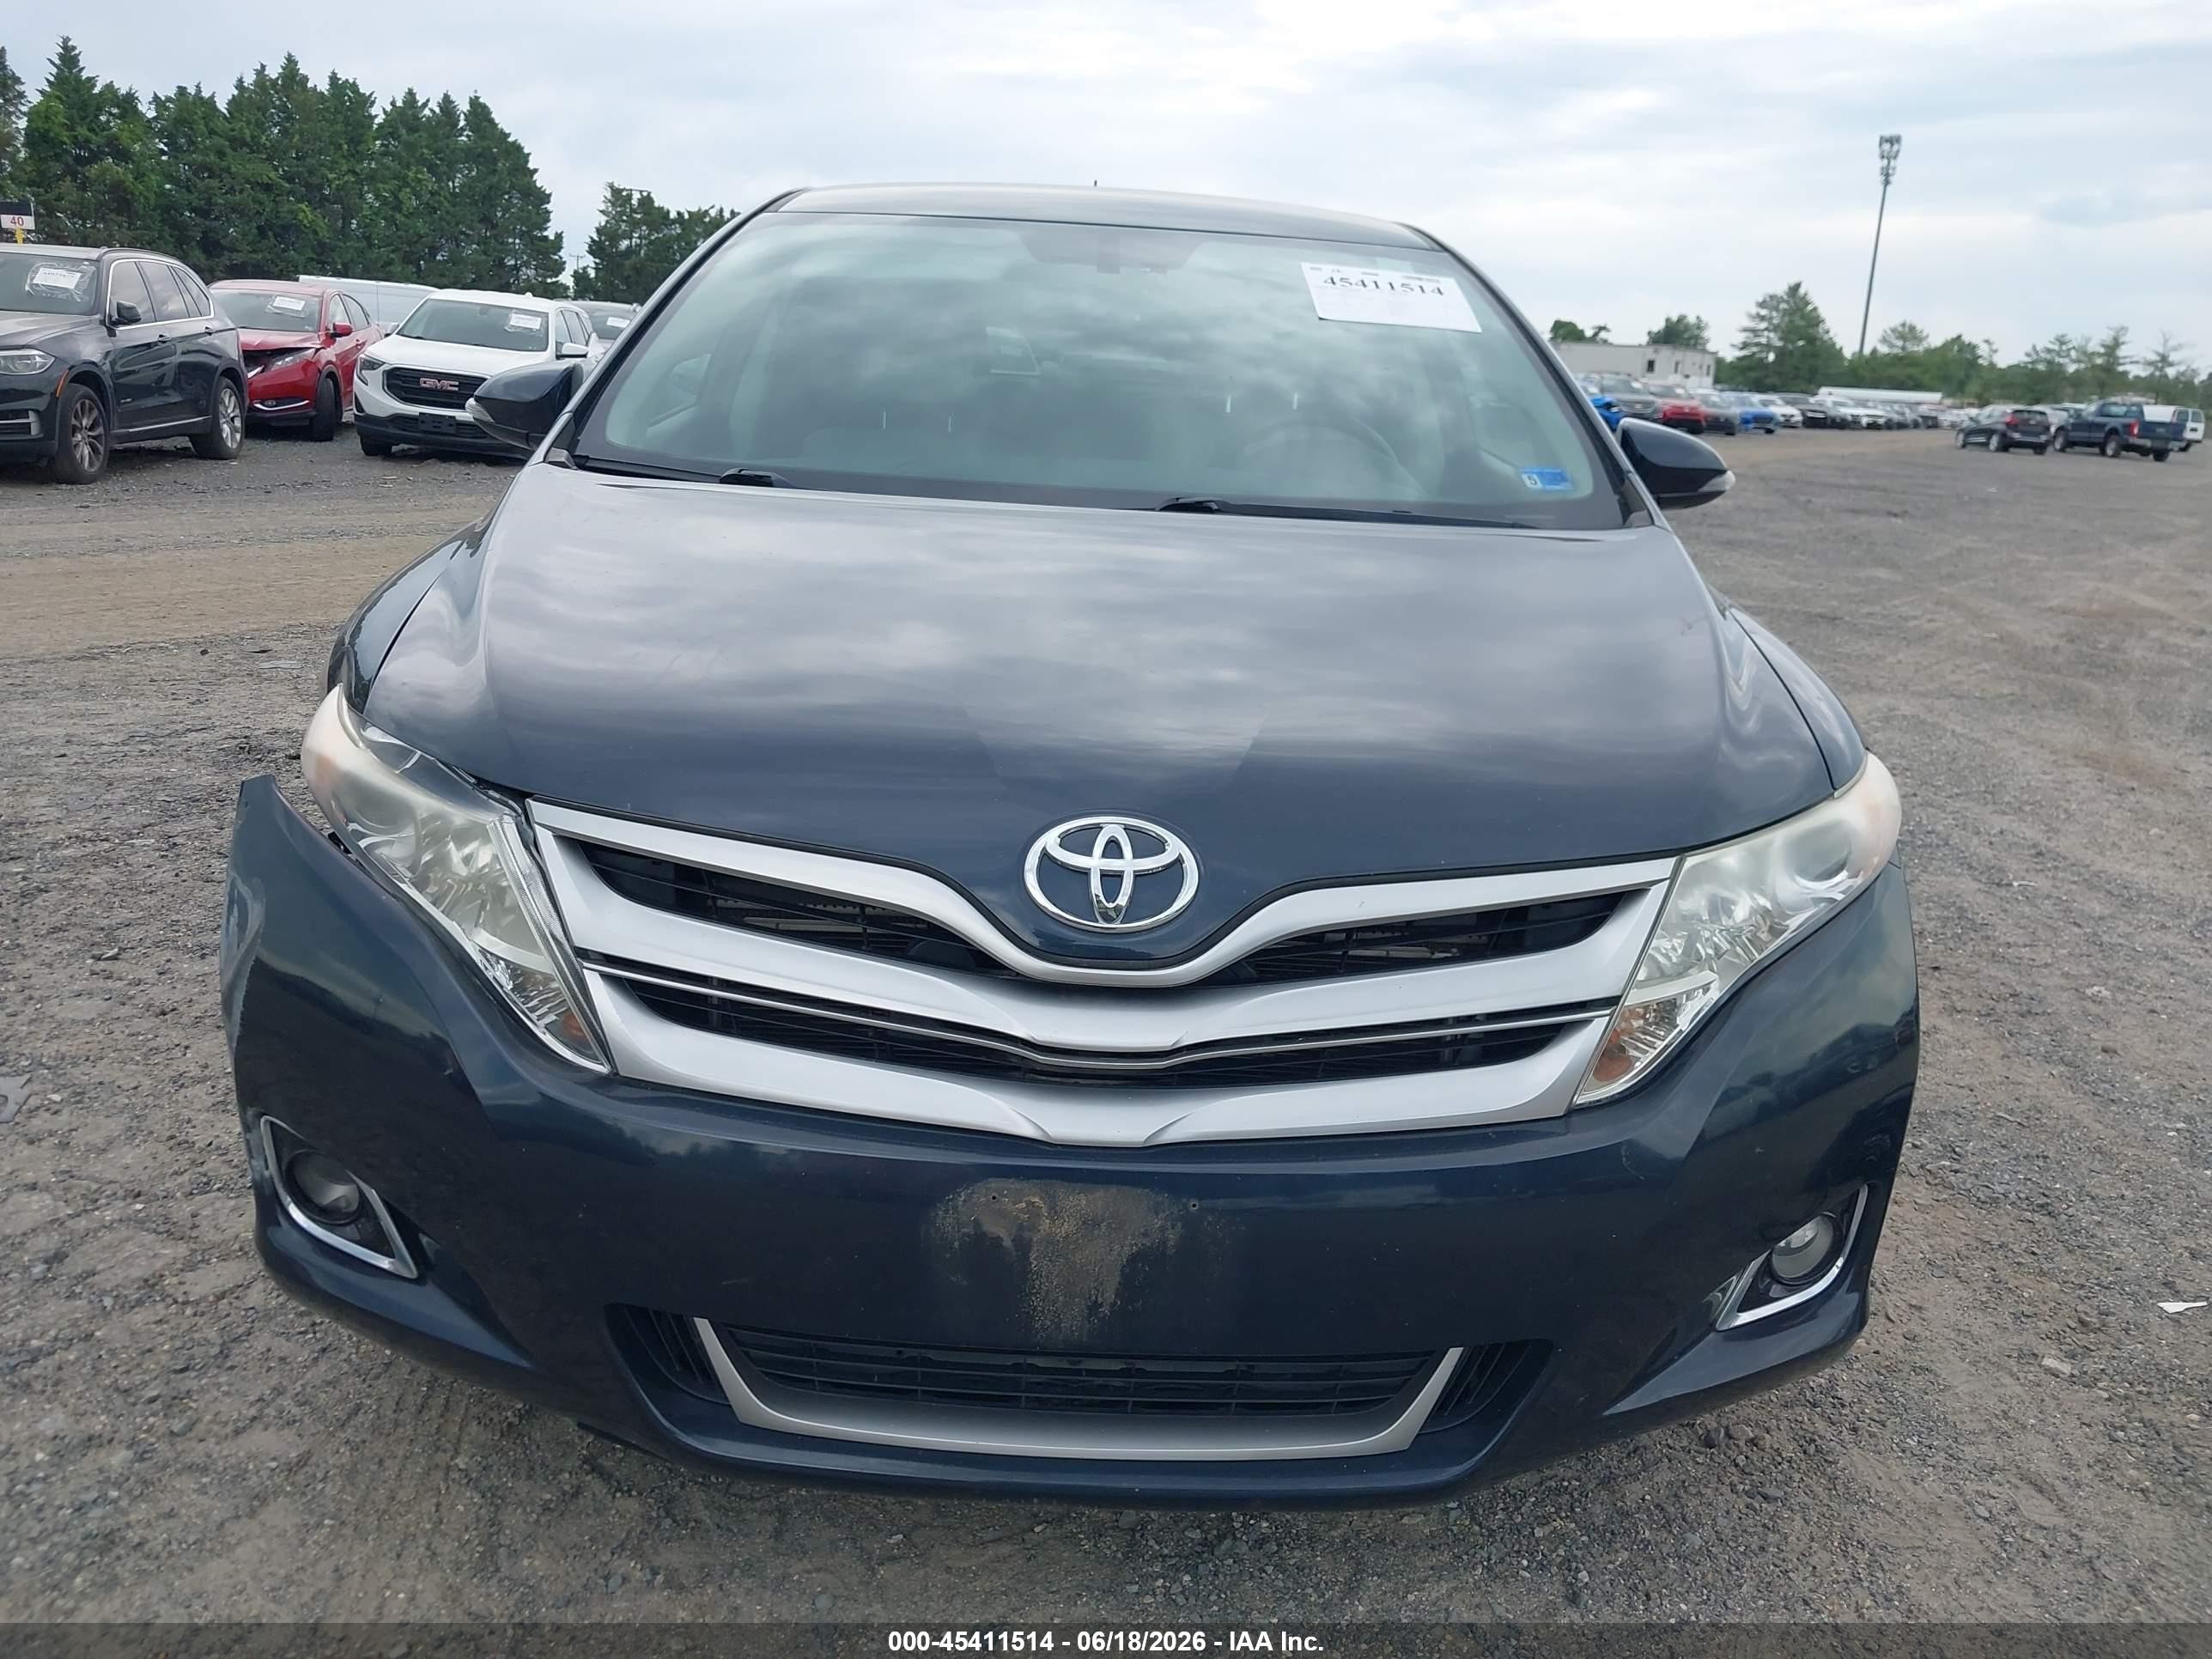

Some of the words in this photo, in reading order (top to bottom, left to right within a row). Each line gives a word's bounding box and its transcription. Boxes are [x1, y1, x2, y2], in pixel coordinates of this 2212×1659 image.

[9, 216, 24, 227] 40
[1322, 276, 1444, 296] 45411514
[419, 377, 459, 392] GMC
